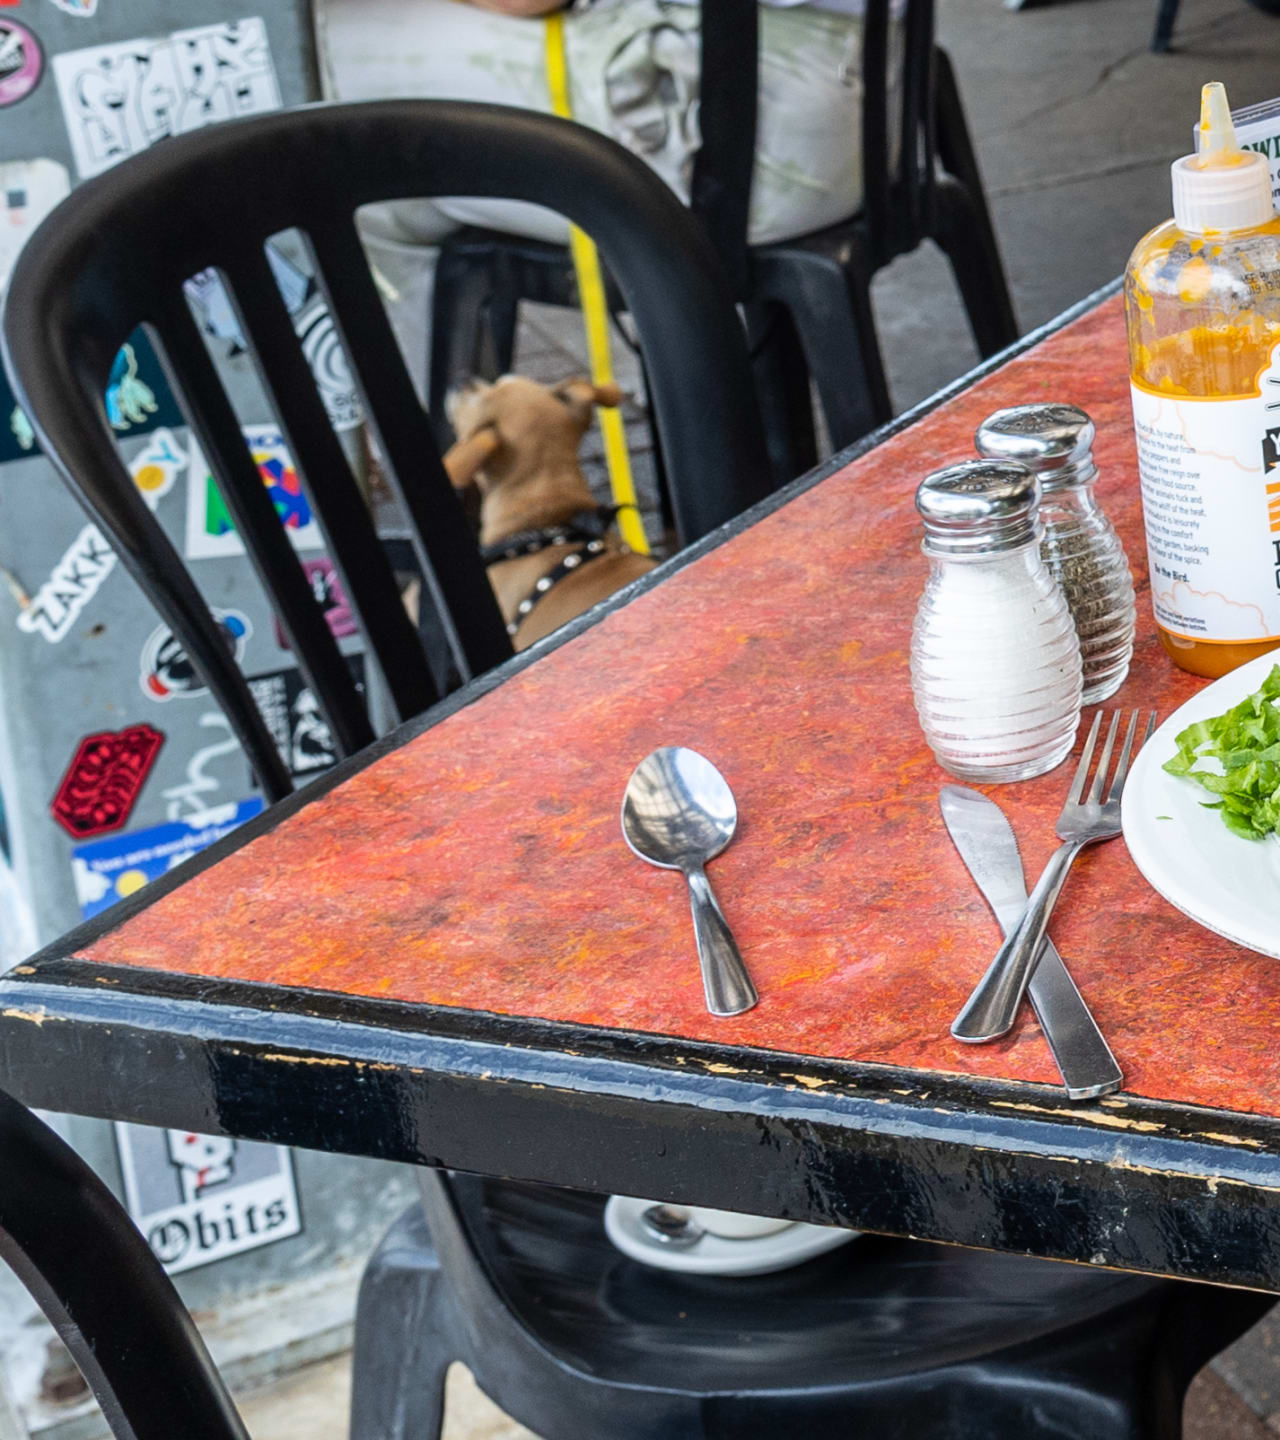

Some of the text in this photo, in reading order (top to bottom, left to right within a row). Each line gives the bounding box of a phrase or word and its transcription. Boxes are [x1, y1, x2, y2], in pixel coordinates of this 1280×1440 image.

[31, 538, 113, 632] ZAKK
[1161, 567, 1171, 578] the
[1172, 569, 1190, 583] Bird.
[148, 1198, 288, 1264] Obits
